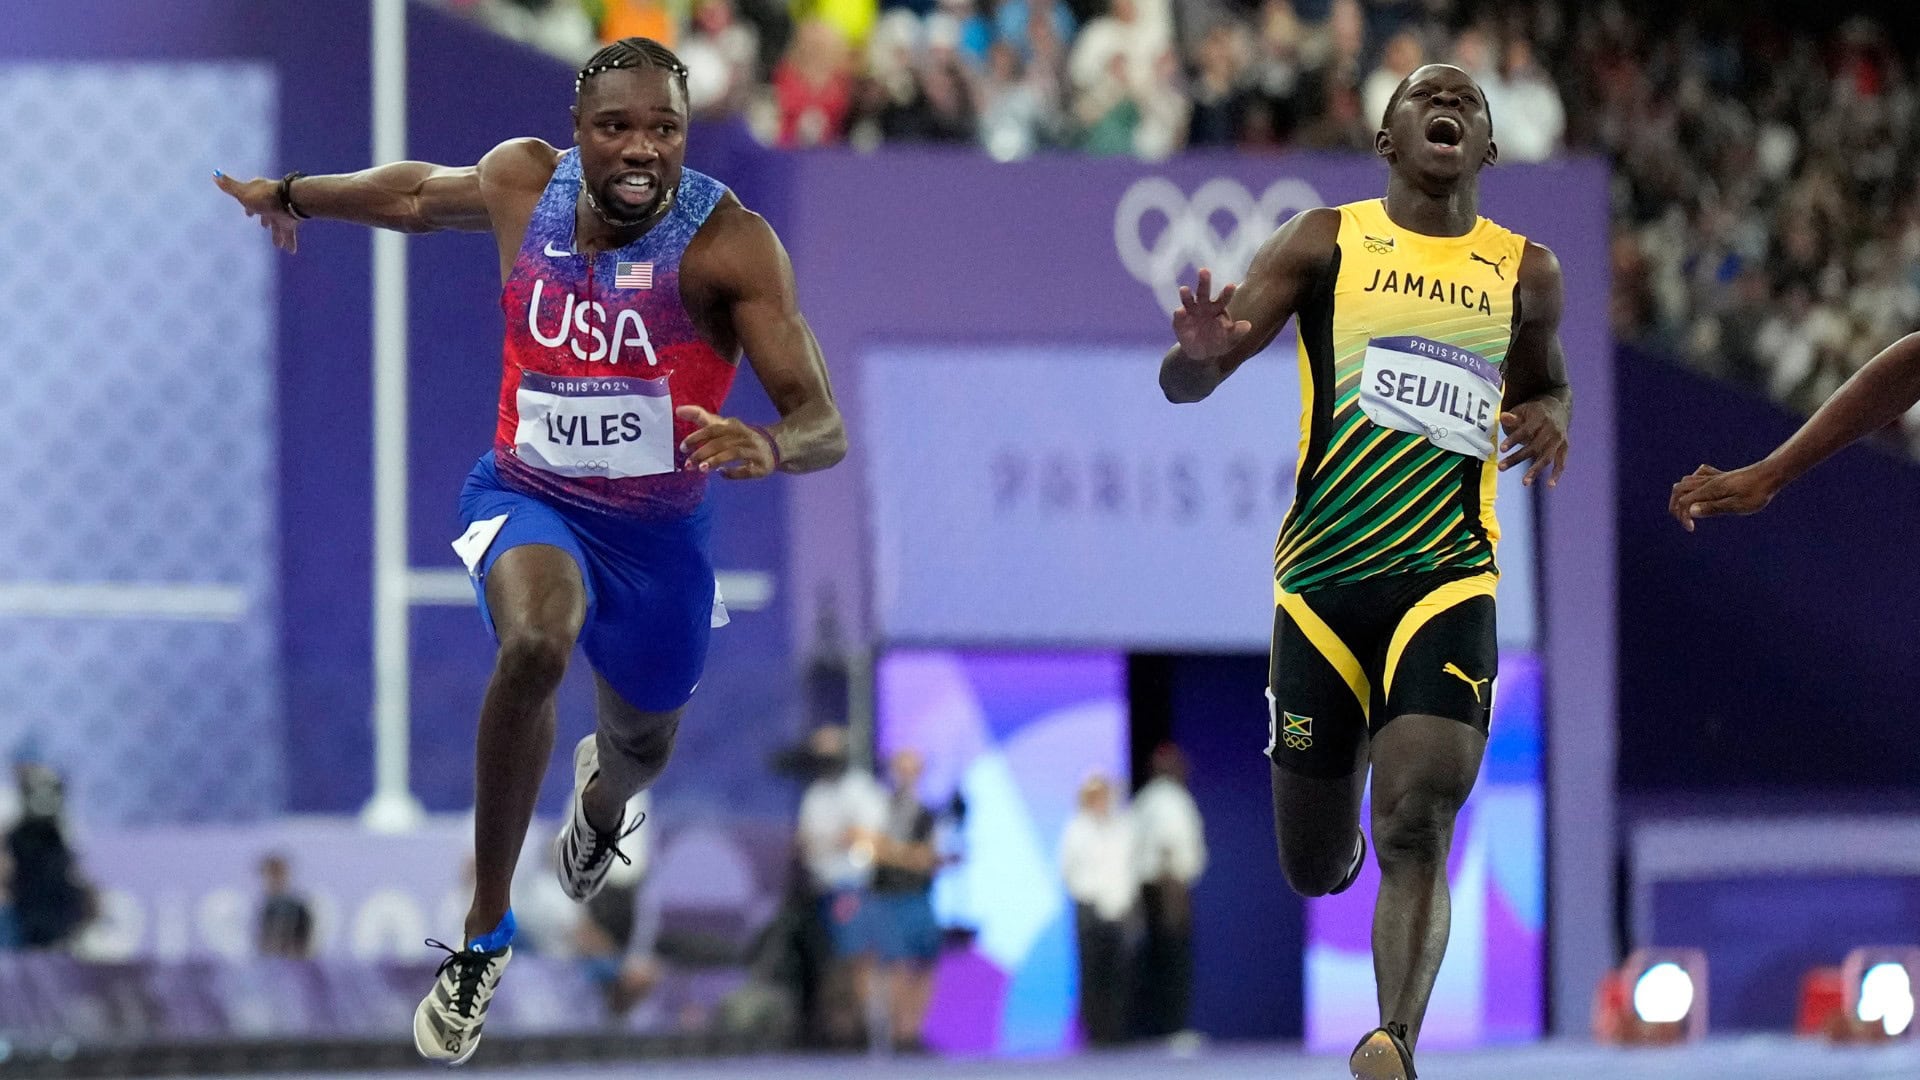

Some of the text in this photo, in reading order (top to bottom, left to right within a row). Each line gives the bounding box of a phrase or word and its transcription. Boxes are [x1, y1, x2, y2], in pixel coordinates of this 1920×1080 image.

[1364, 269, 1491, 316] JAMAICA
[528, 279, 657, 366] USA
[1410, 340, 1481, 370] PARIS 2024
[550, 381, 629, 393] PARIS 2024
[1374, 369, 1490, 433] SEVILLE
[546, 412, 642, 447] LYLES
